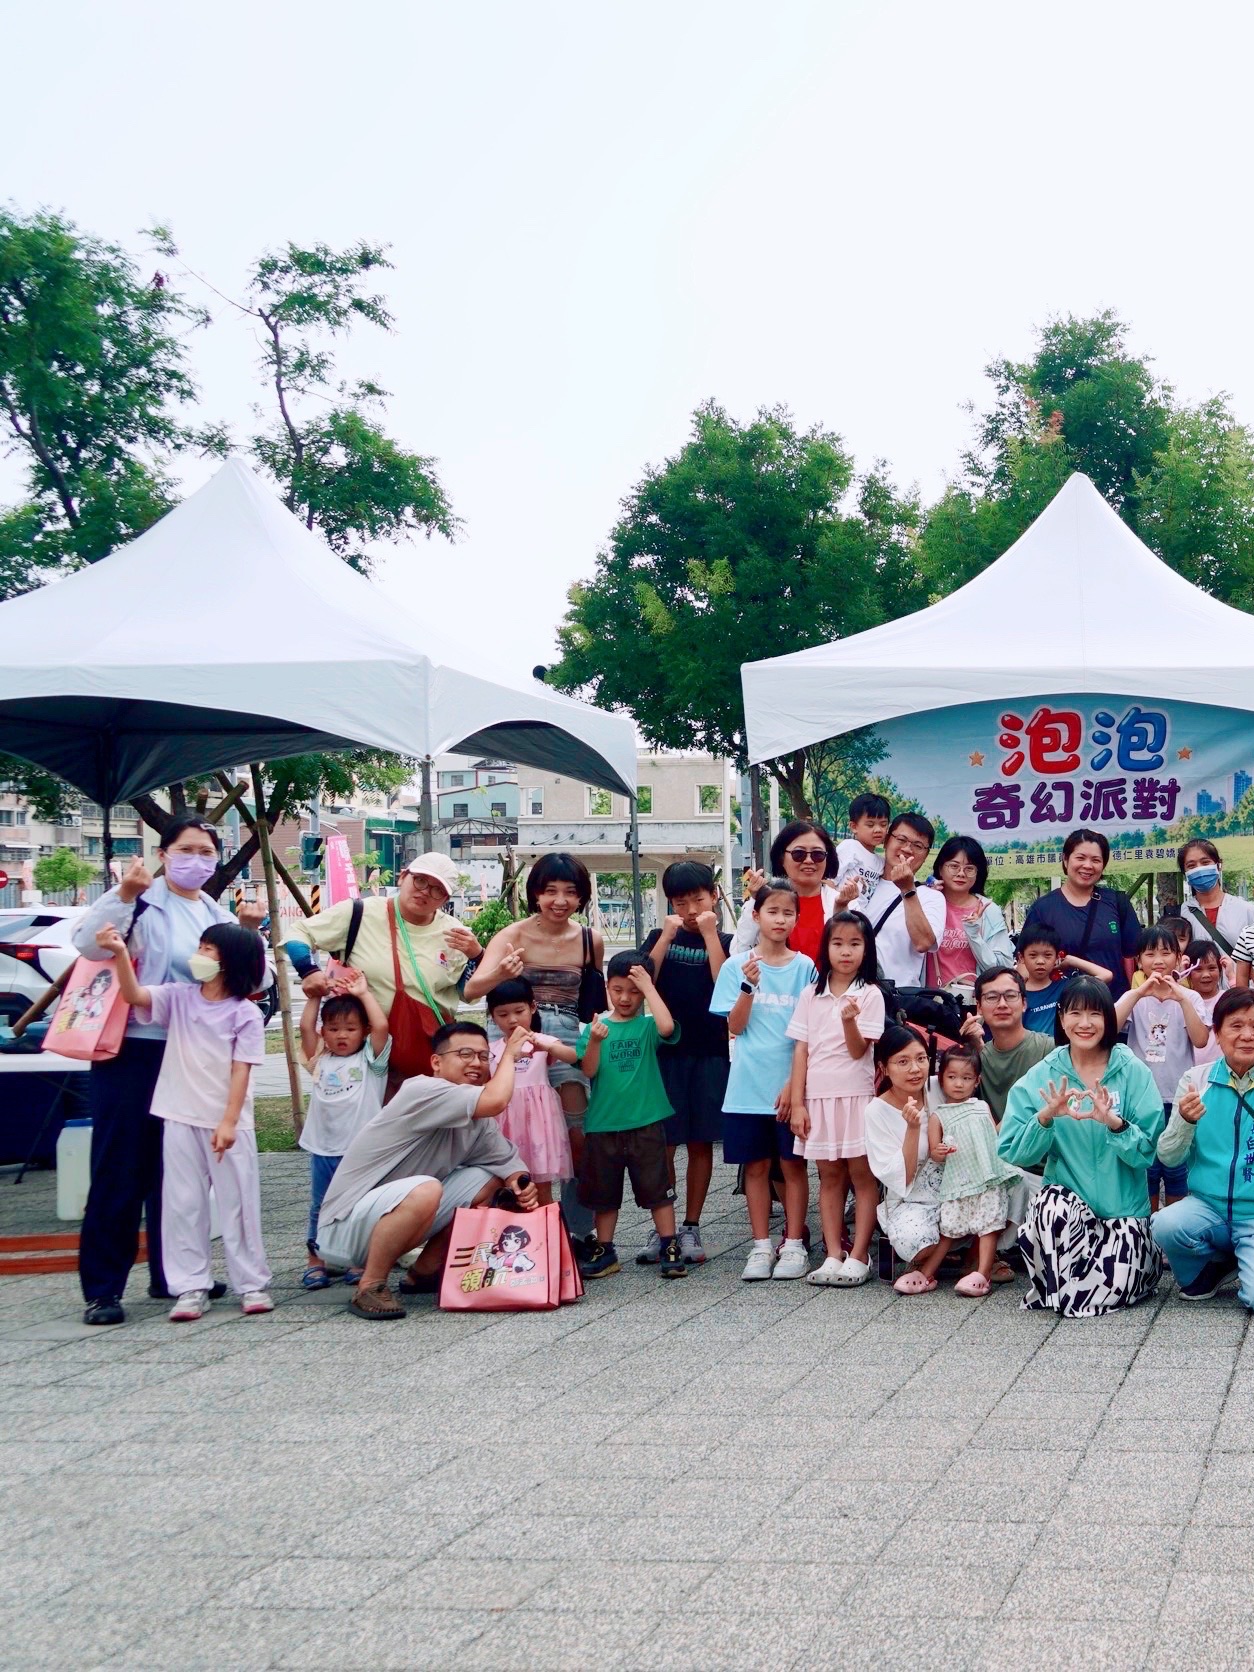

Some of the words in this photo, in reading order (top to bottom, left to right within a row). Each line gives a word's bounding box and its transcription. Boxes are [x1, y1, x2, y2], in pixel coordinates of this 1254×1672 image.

[999, 707, 1167, 776] 泡泡
[972, 778, 1181, 830] 奇幻派對
[611, 1049, 640, 1060] WORLD
[612, 1040, 639, 1049] FAIRY
